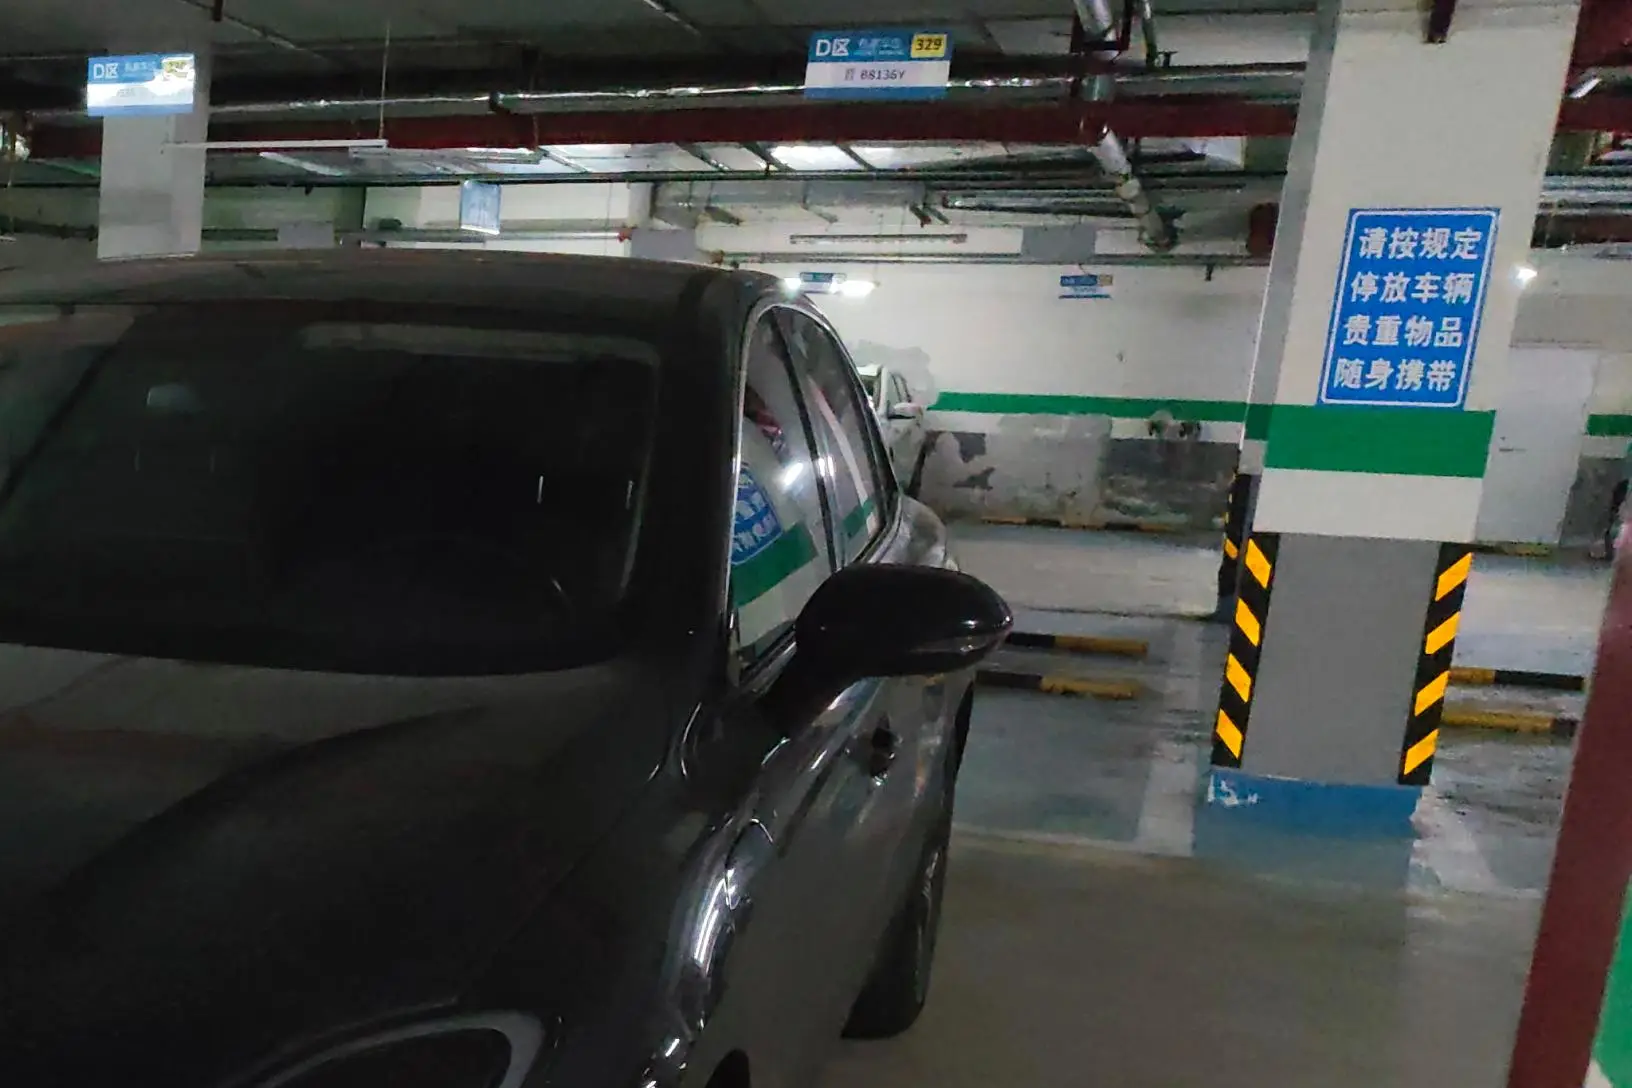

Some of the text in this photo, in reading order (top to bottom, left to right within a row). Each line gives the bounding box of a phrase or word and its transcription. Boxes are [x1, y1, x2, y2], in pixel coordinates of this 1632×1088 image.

[815, 38, 850, 56] D区
[915, 37, 944, 51] 329
[93, 63, 119, 80] D区
[1358, 226, 1482, 260] 请按规定
[1350, 271, 1476, 304] 停放车辆
[1342, 313, 1464, 348] 贵重物品
[1333, 357, 1457, 392] 随身携带
